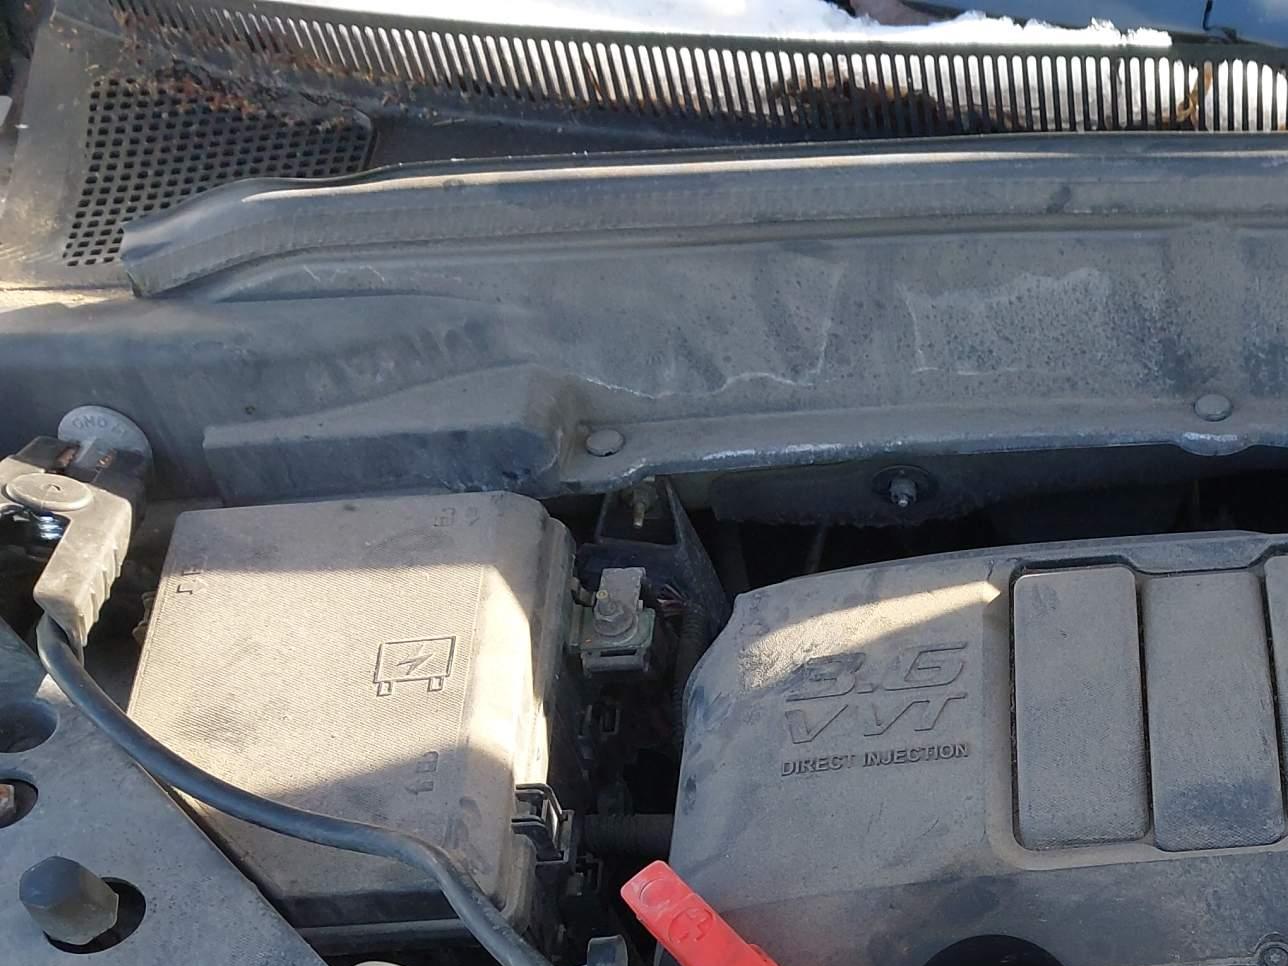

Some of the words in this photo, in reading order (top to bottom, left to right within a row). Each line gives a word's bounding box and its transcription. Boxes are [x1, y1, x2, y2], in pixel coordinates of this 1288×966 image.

[784, 693, 967, 744] VVT
[781, 755, 856, 777] DIRECT
[863, 743, 969, 768] INJECTION
